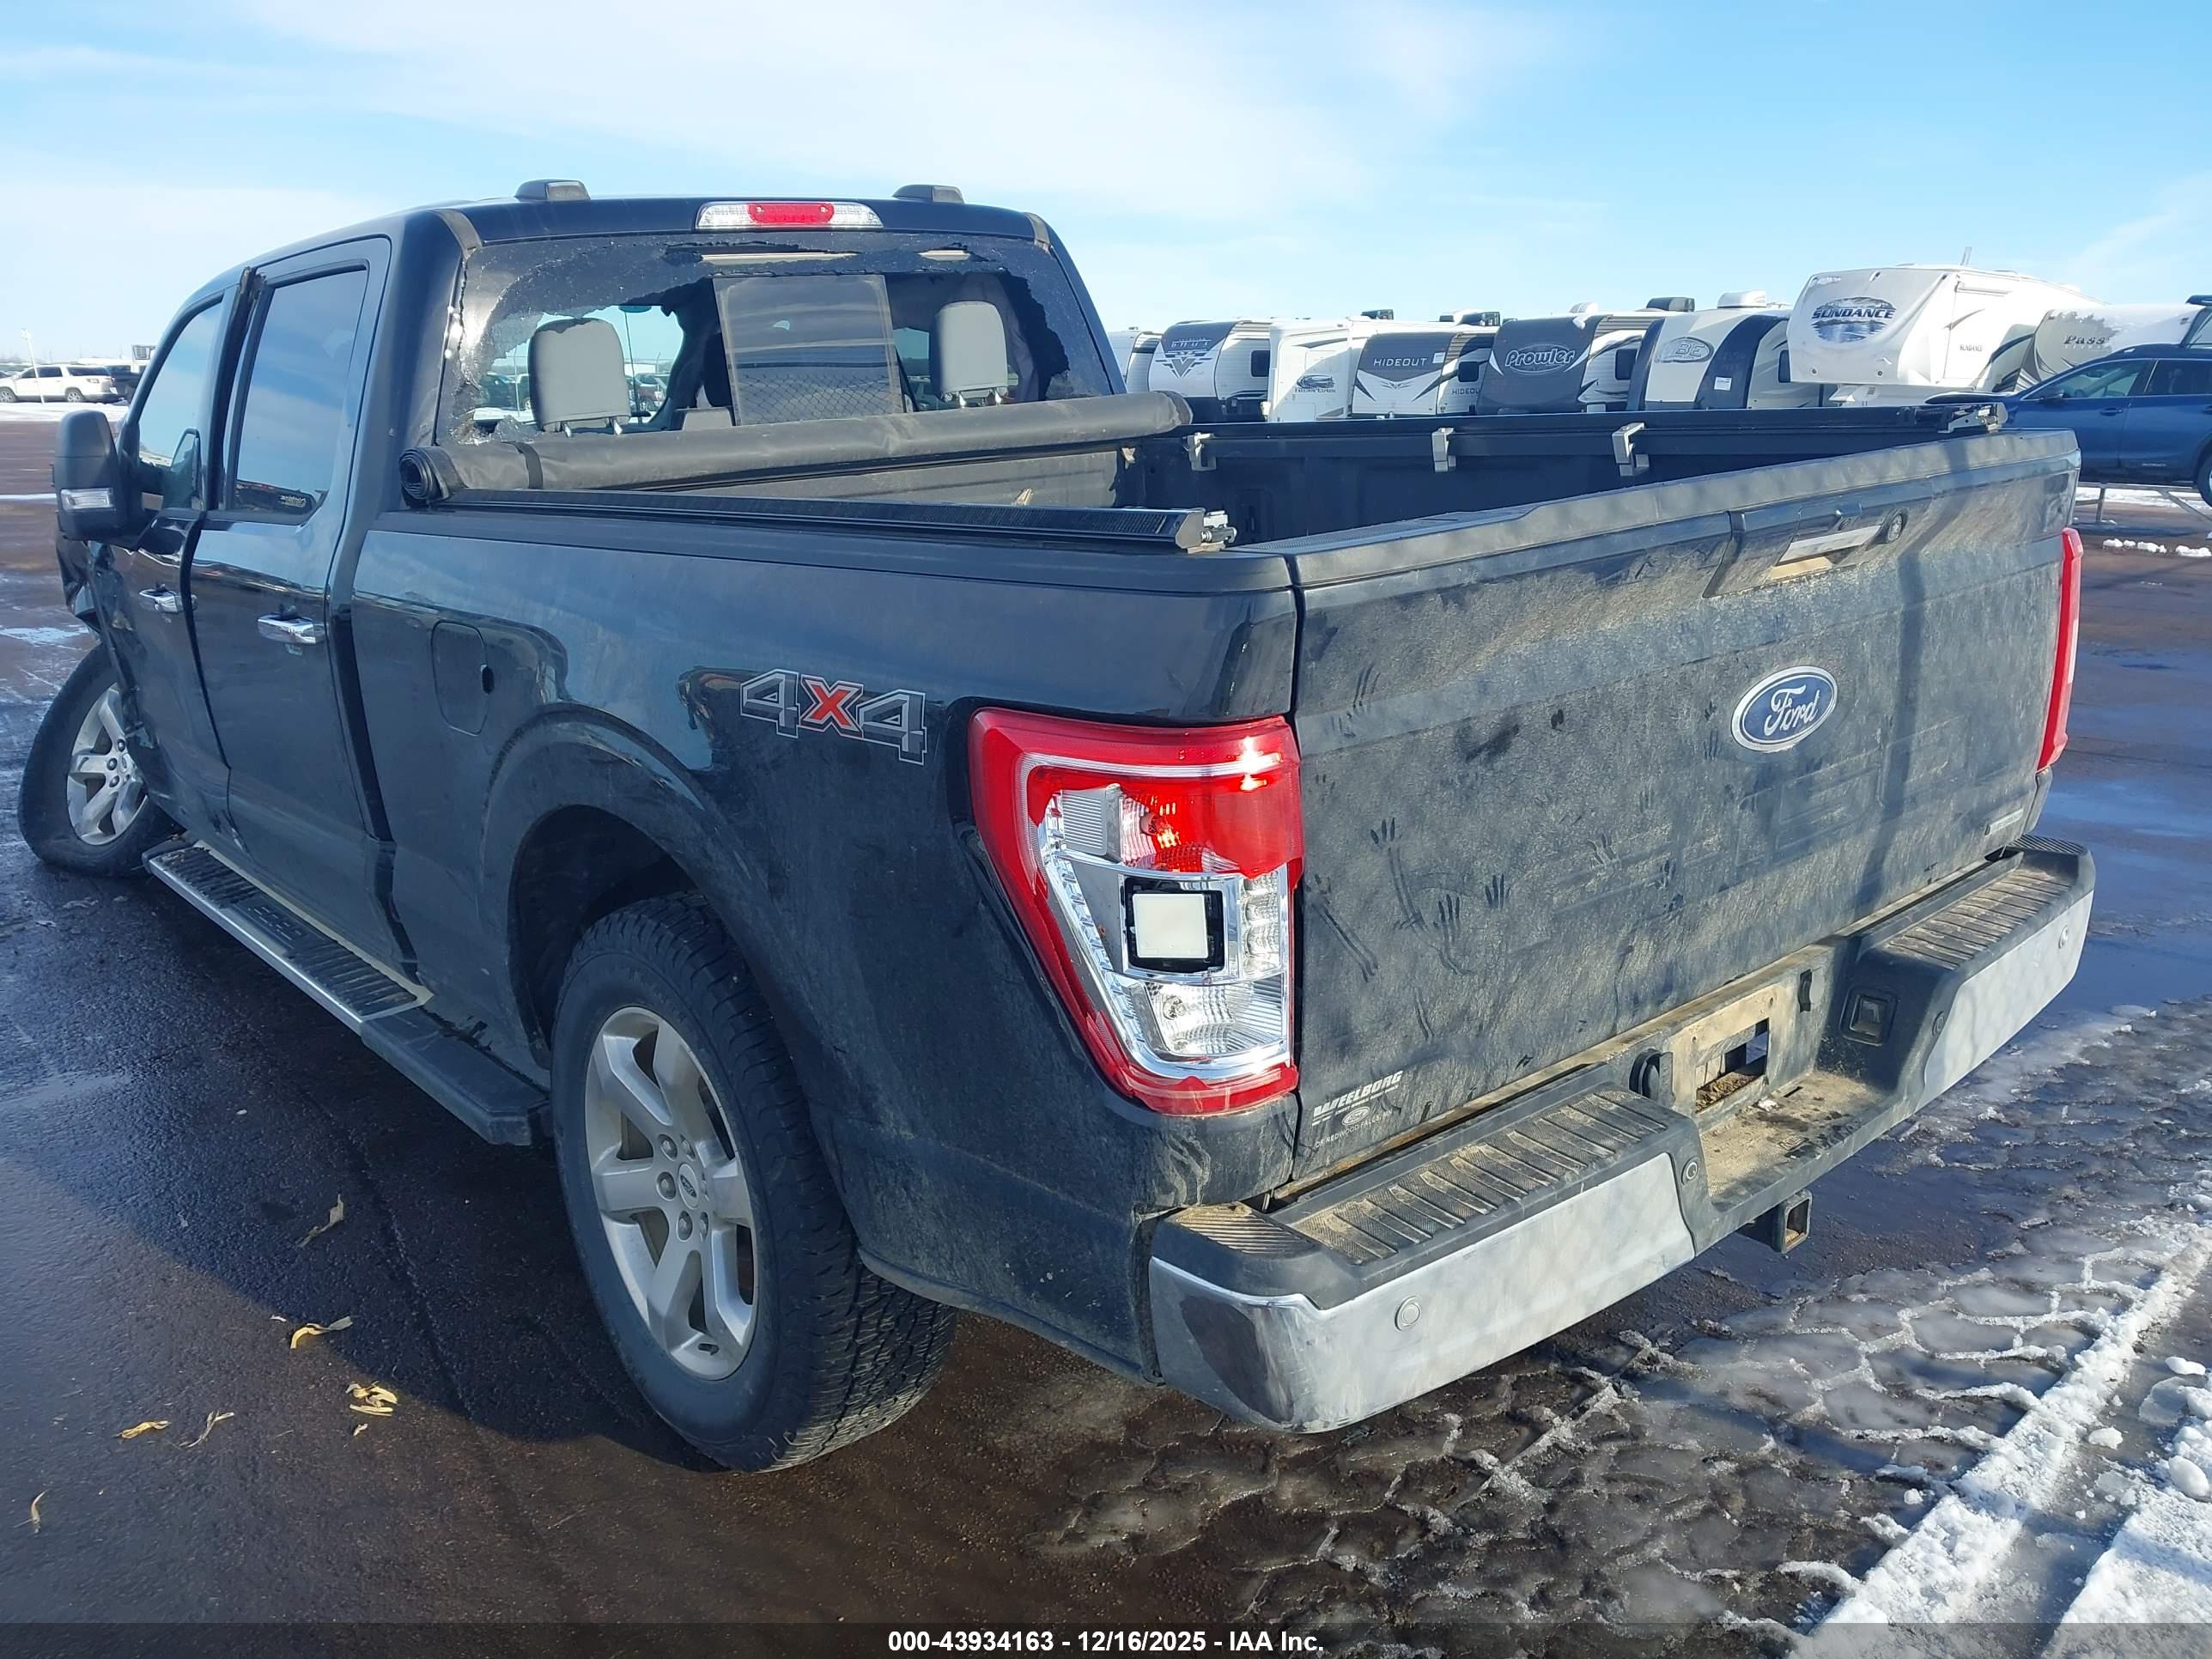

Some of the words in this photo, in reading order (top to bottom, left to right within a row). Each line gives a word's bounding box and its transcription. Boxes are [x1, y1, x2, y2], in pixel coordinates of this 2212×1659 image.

[1811, 307, 1897, 319] SUNDANCE
[2063, 335, 2110, 344] Pass
[1373, 357, 1428, 367] HIDEOUT
[1504, 347, 1576, 367] Prowler
[1763, 684, 1820, 737] Ford
[1313, 1070, 1404, 1118] WEELBORG
